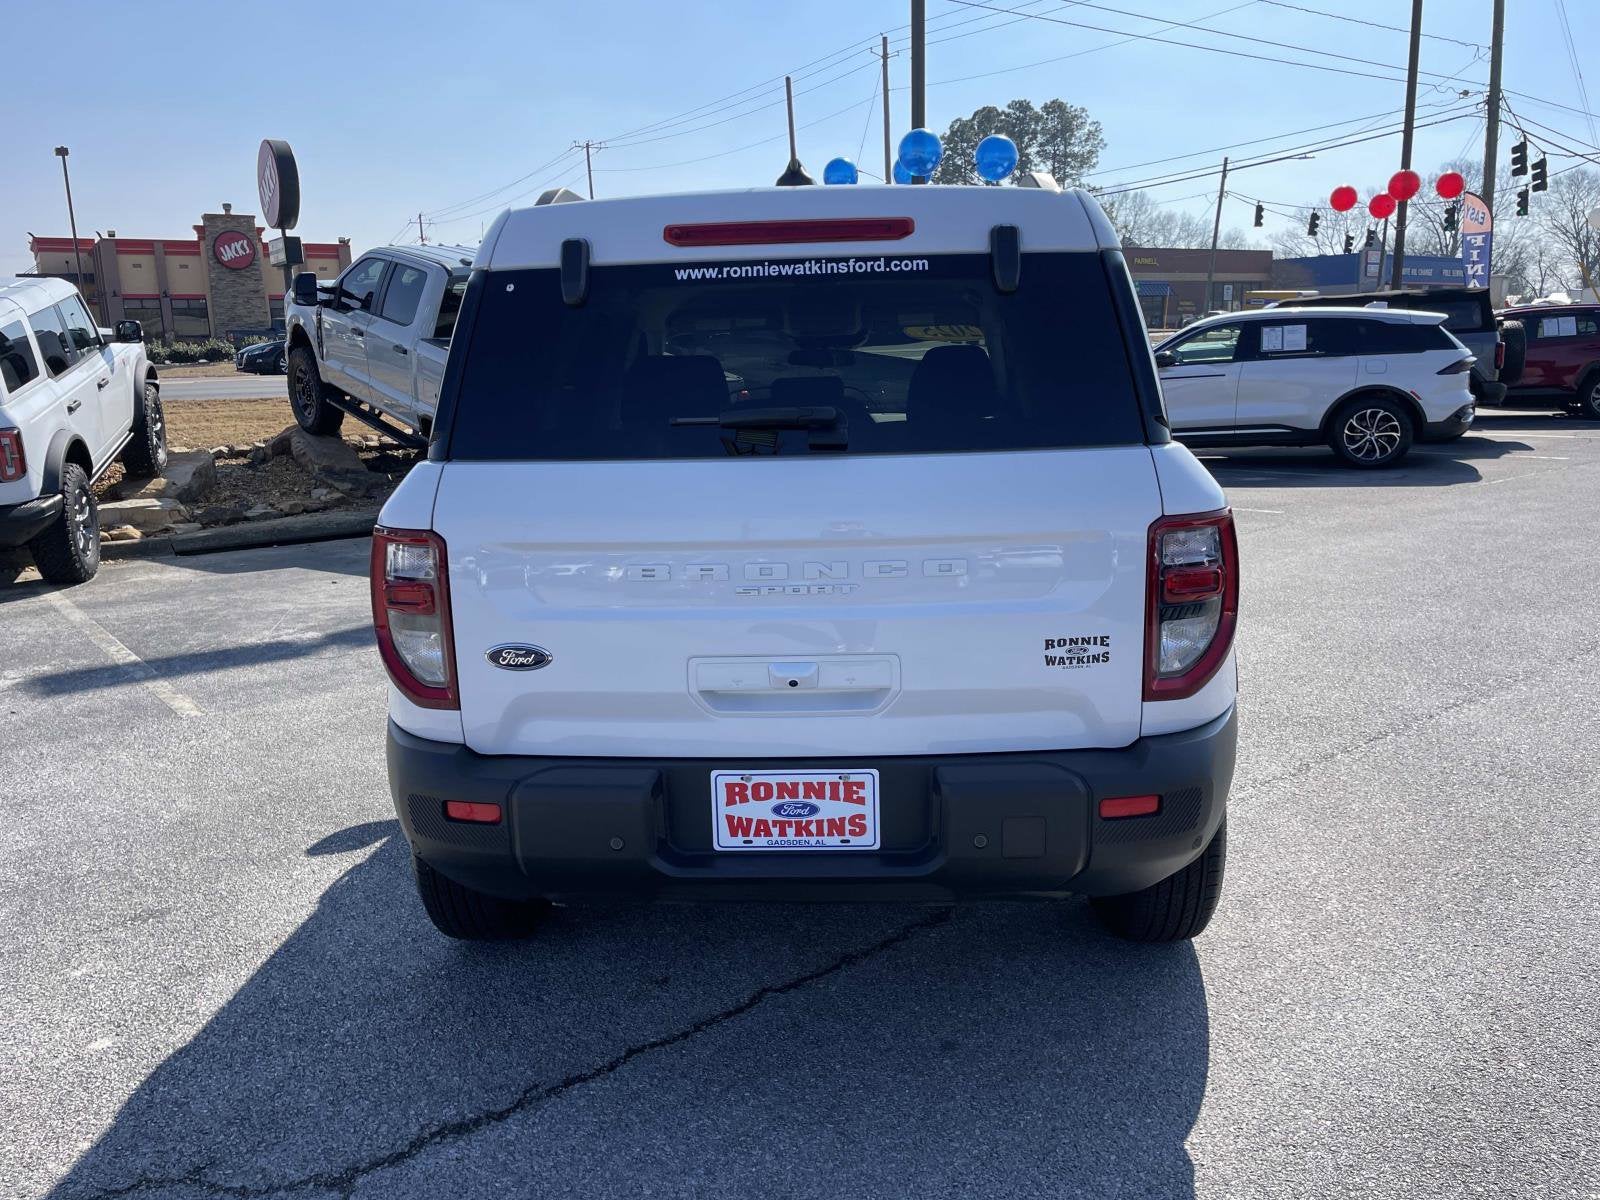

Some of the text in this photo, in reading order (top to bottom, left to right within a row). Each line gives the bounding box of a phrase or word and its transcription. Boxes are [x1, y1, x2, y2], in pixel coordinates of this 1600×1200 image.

[220, 240, 250, 261] JACK'S
[674, 257, 929, 281] www.ronniewatkinsford.com
[626, 558, 968, 582] BRONCO
[736, 583, 861, 597] SPORT
[1044, 635, 1110, 651] RONNIE
[1044, 651, 1110, 666] WATKINS
[724, 781, 866, 807] RONNIE
[780, 803, 810, 816] Ford
[725, 813, 868, 838] WATKINS
[766, 839, 814, 847] GADSDEN,
